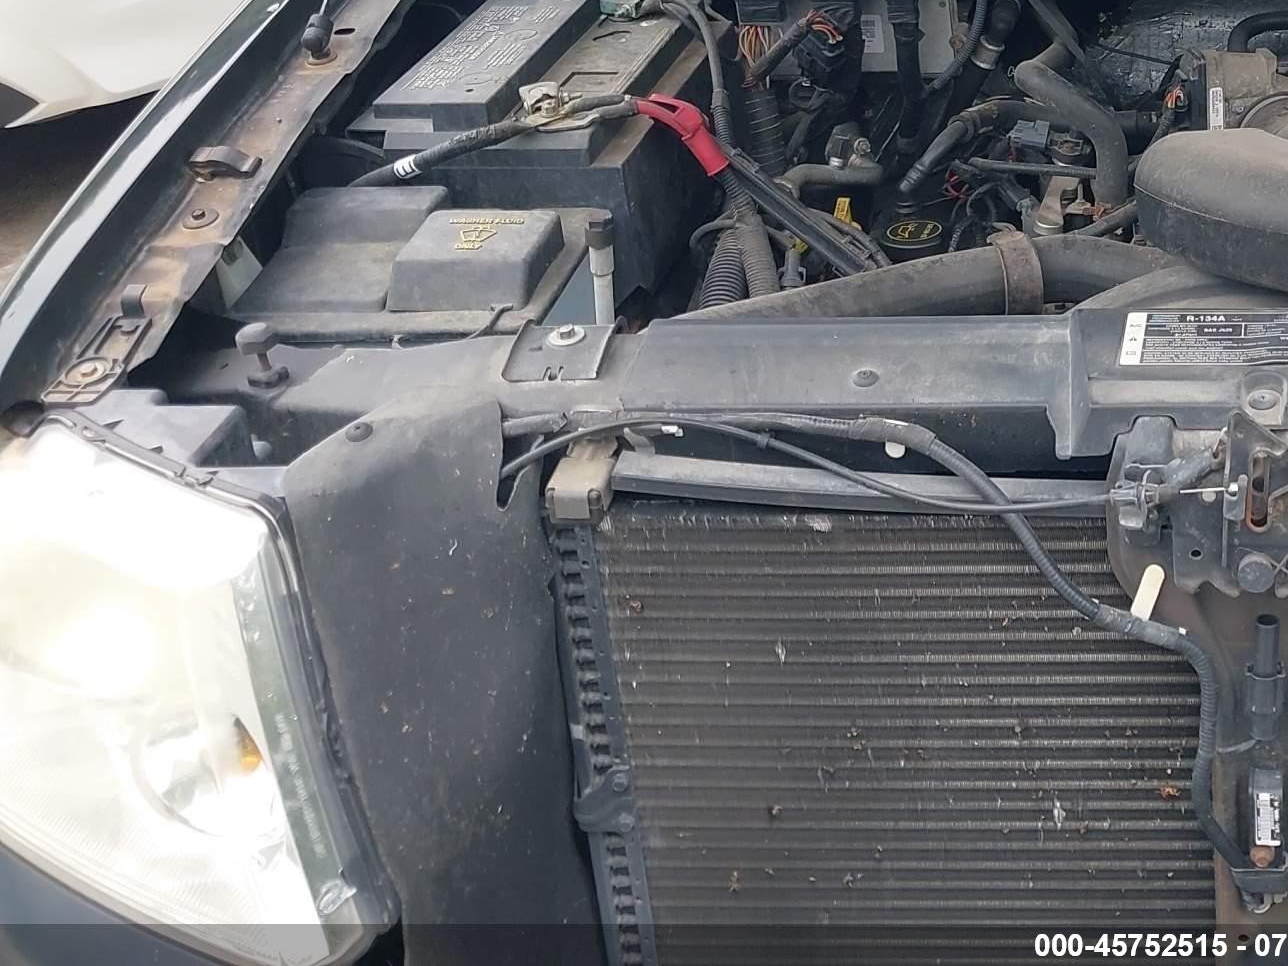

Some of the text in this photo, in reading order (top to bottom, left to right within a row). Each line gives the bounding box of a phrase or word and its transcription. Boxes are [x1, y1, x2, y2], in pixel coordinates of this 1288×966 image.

[448, 217, 525, 226] WASHER FLUID
[453, 242, 483, 251] ONLY
